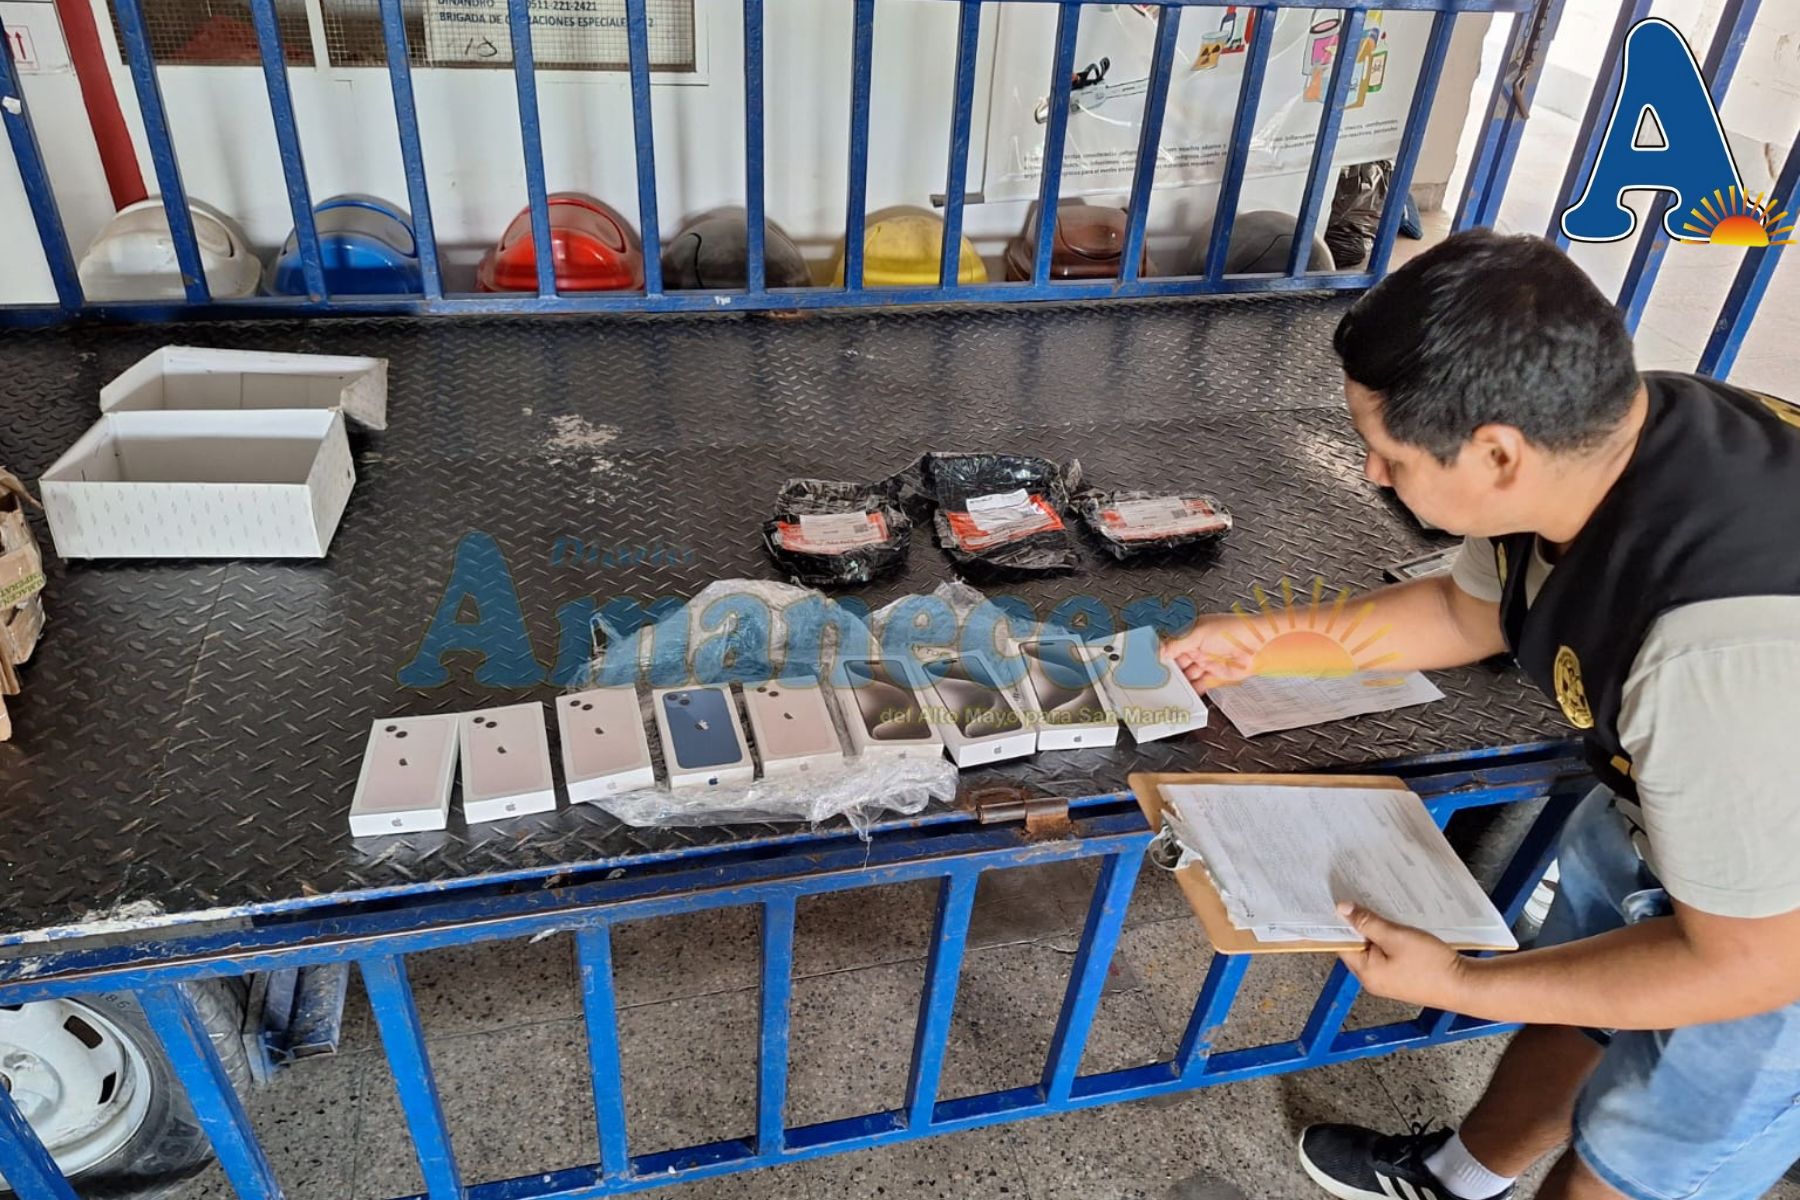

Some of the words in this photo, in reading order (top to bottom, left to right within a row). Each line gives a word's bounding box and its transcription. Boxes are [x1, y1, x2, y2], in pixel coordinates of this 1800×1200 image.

[439, 12, 487, 24] BRIGADA
[489, 14, 503, 24] DE
[578, 16, 628, 28] ESPECIALE
